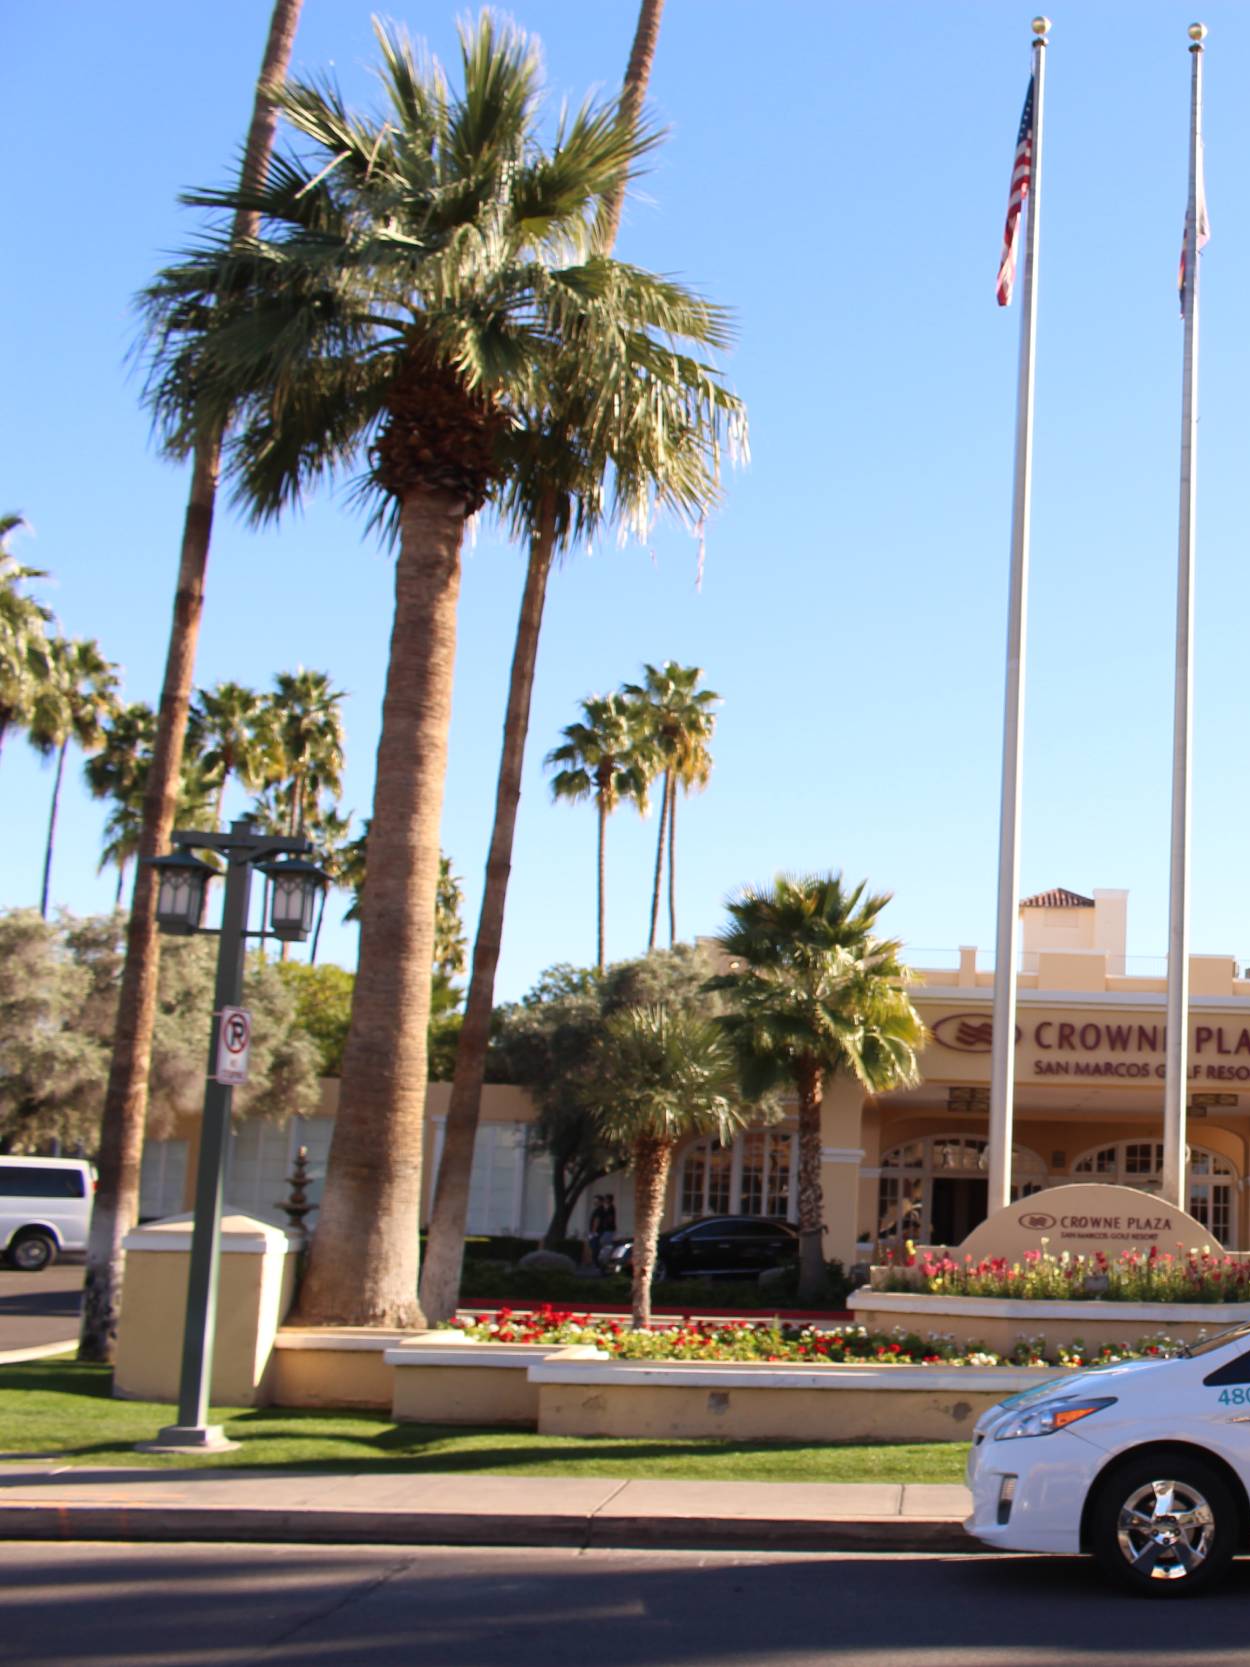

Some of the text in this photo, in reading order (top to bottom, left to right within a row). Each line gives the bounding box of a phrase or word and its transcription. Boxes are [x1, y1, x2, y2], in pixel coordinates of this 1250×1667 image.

[1034, 1021, 1167, 1053] CROWN
[1034, 1060, 1070, 1076] SAN
[1074, 1061, 1150, 1078] MARCOS
[1060, 1215, 1172, 1231] CROWNE PLAZA
